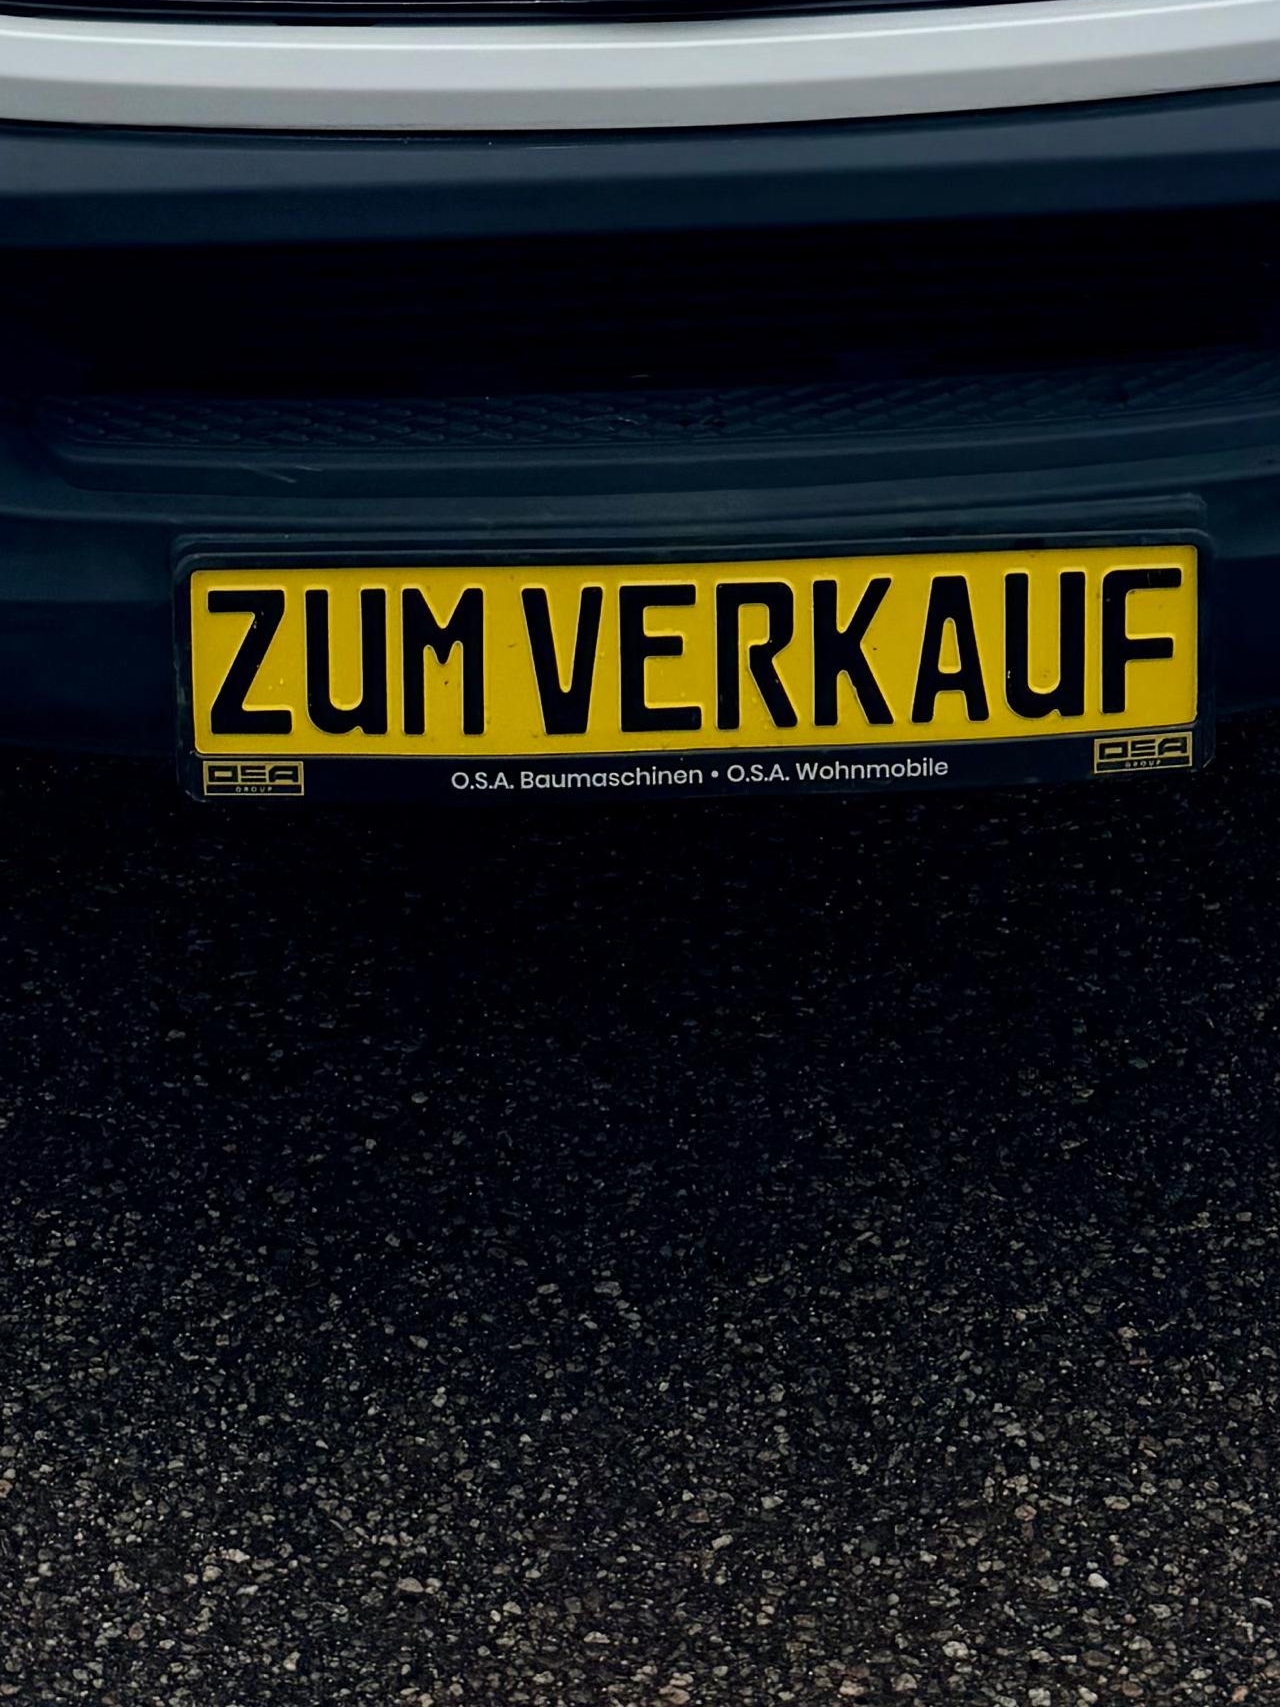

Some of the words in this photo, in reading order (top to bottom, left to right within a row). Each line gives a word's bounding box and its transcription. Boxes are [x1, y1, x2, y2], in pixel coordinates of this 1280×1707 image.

[206, 586, 486, 736] ZUM
[520, 567, 1183, 736] VERKAUF
[451, 771, 515, 790] O.S.A.
[520, 765, 703, 789] Baumaschinen
[727, 763, 790, 783] O.S.A.
[795, 757, 949, 781] Wohnmobile
